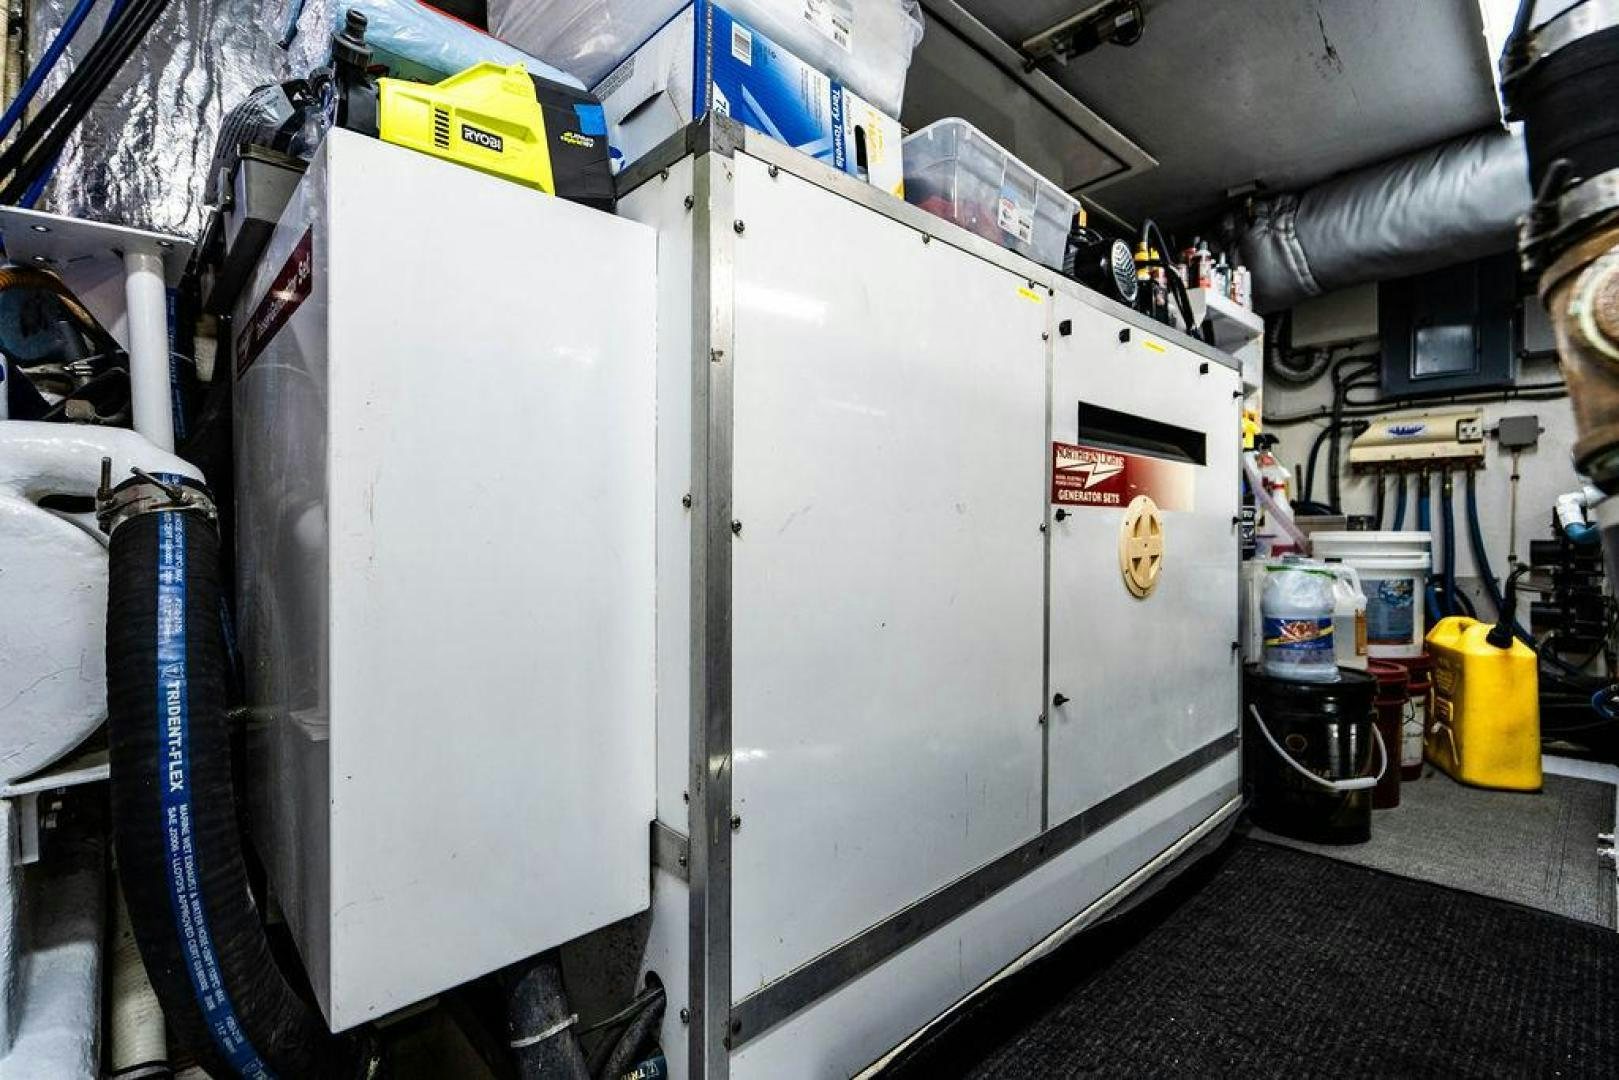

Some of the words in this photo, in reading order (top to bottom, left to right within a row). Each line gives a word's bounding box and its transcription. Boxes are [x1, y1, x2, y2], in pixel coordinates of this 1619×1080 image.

[832, 88, 842, 121] Terry
[464, 127, 501, 150] RYOBI
[833, 124, 846, 168] Towels
[1057, 489, 1102, 503] GENERATOR
[1103, 492, 1121, 504] SETS
[167, 681, 185, 791] TRIDENT-FLEX
[179, 804, 190, 836] MARINE
[182, 837, 192, 854] WET
[168, 807, 177, 825] SAE
[178, 894, 194, 938] APPROVED
[185, 856, 197, 890] EXHAUST
[191, 900, 203, 925] WATER
